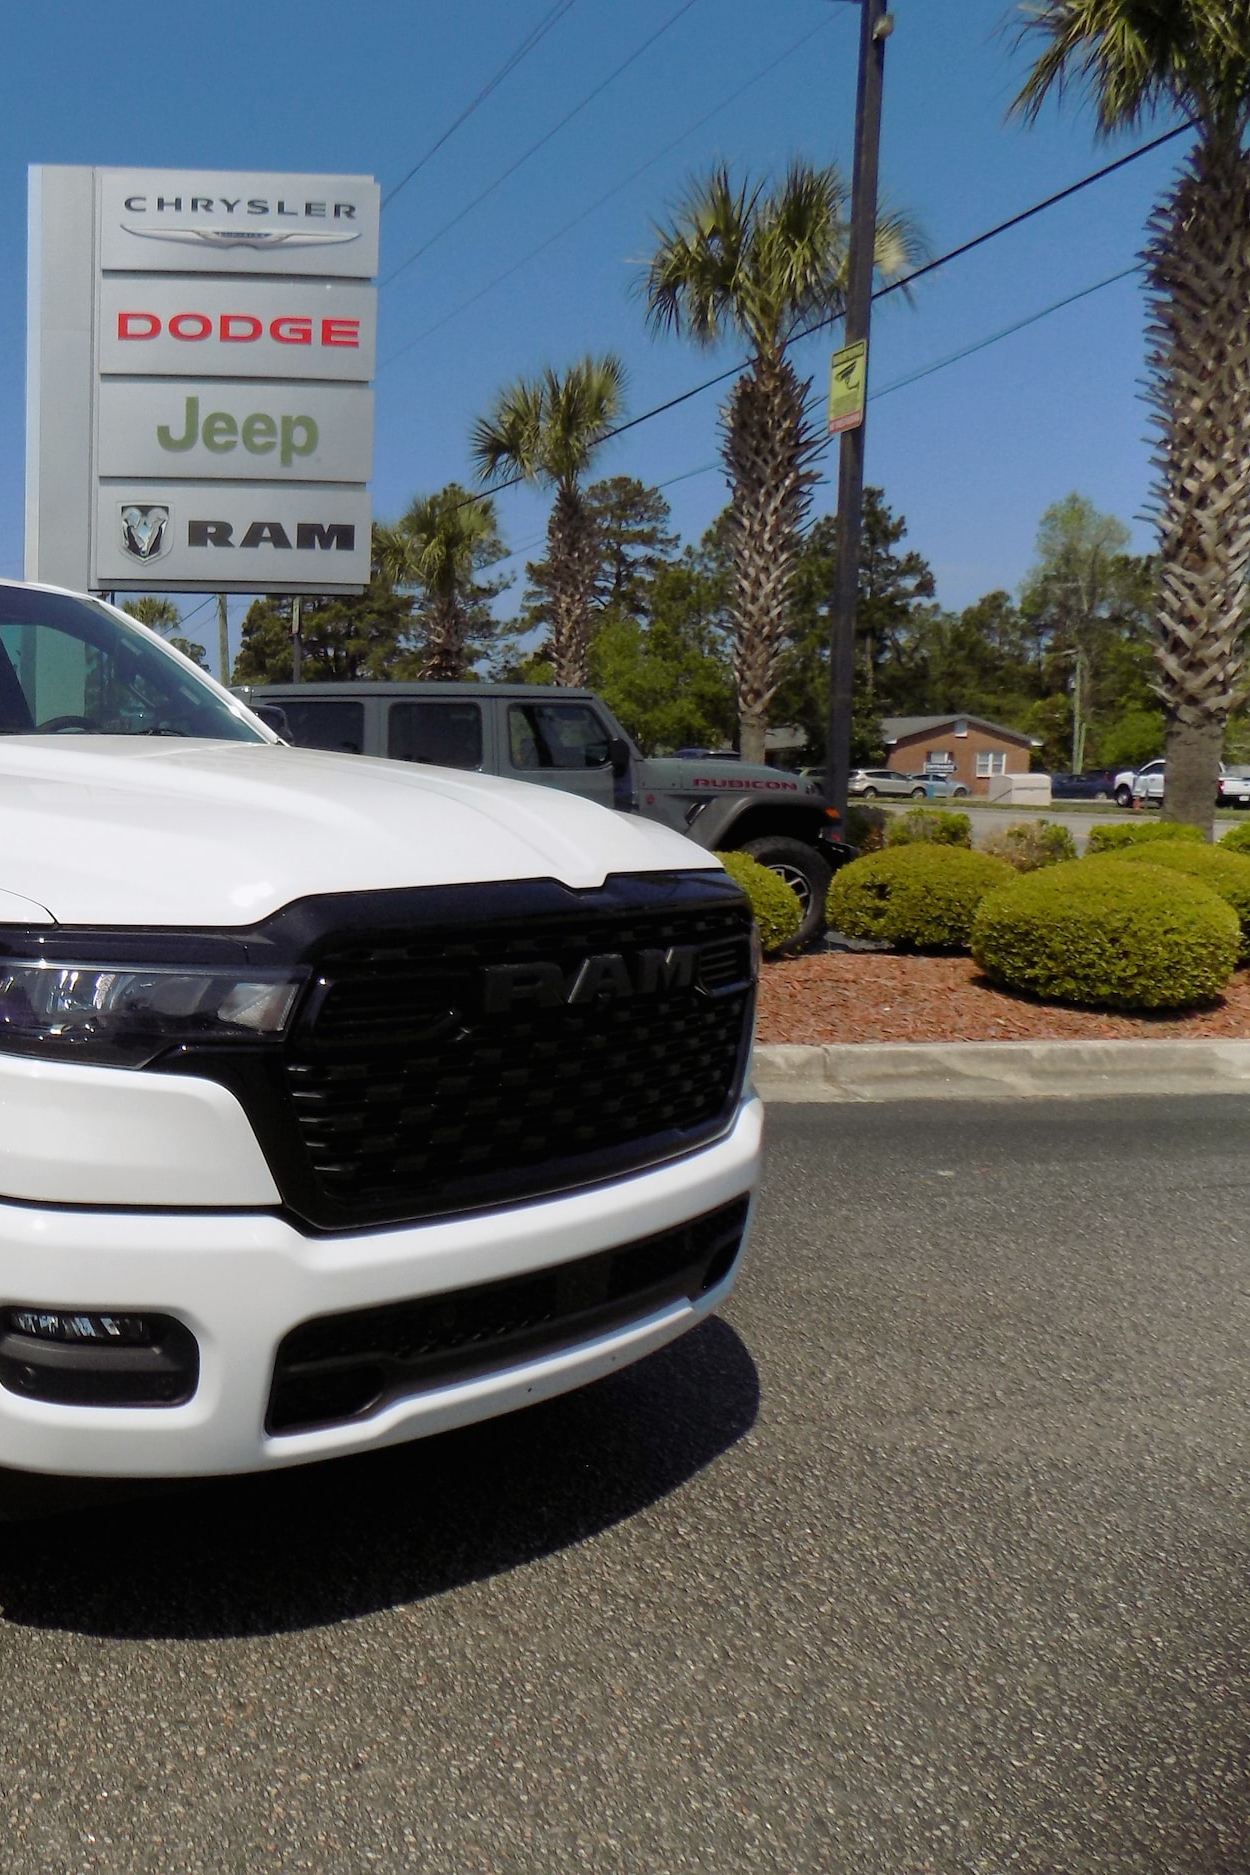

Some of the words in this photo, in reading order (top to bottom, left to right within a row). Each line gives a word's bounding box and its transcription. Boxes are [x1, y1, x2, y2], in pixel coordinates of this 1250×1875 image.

[124, 196, 357, 219] CHRYSLER
[118, 313, 360, 348] DODGE
[157, 396, 319, 468] Jeep
[188, 520, 356, 551] RAM
[692, 778, 798, 791] RUBICON
[479, 945, 701, 1014] RAM
